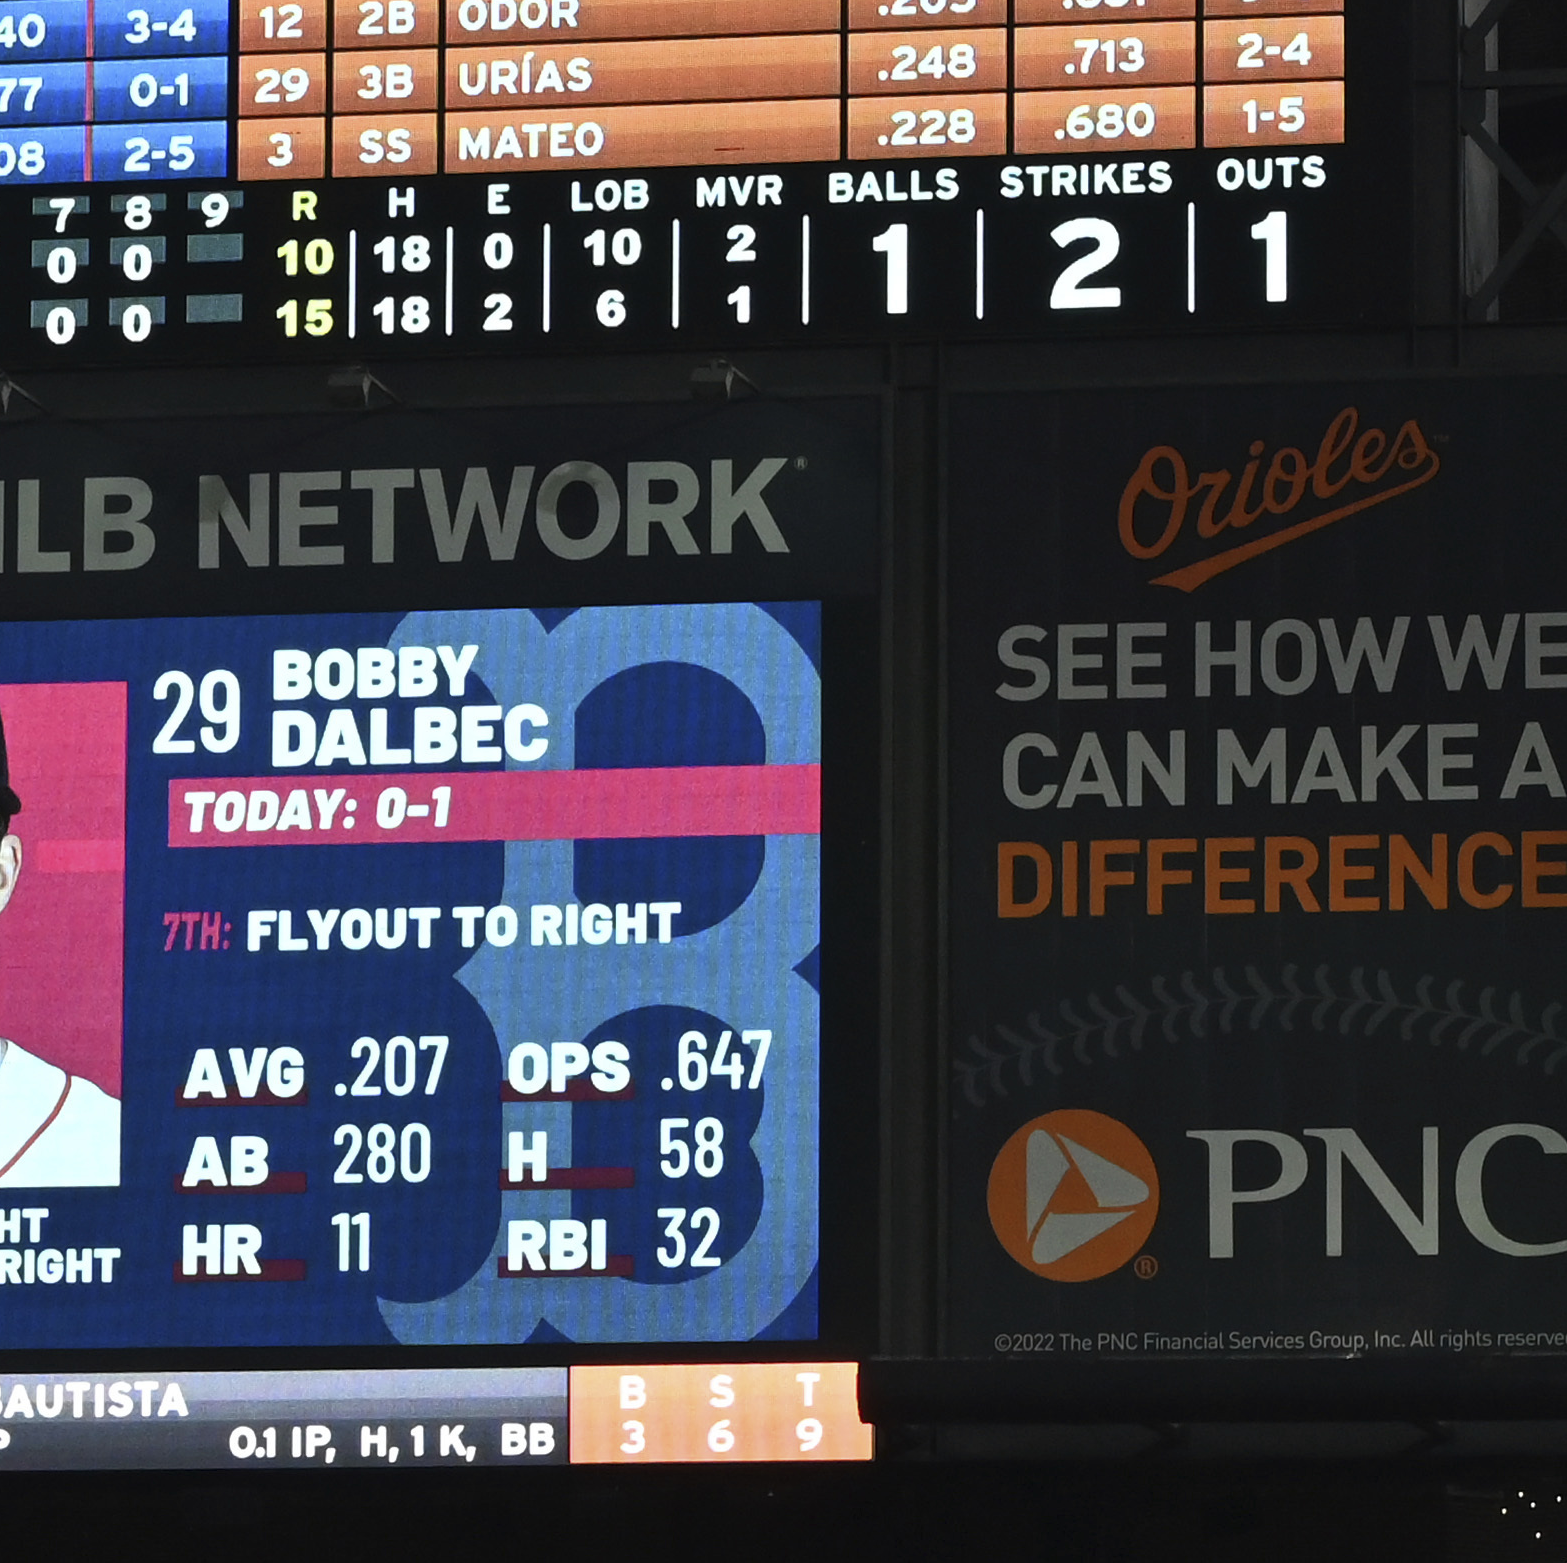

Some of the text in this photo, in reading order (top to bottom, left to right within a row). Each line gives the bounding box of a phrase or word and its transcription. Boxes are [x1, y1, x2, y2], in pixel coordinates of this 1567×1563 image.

[459, 51, 593, 96] URÍAS
[458, 121, 604, 161] MATEO
[292, 155, 1326, 221] R H E LOB MVR BALLS STRIKES OUTS
[276, 238, 334, 276] 10
[373, 235, 431, 273] 18
[483, 232, 514, 270] 0
[583, 228, 642, 266] 10
[725, 224, 756, 262] 2
[872, 211, 1287, 314] 1 2 1
[276, 298, 334, 338] 15
[373, 295, 431, 335] 18
[482, 293, 513, 331] 2
[596, 289, 627, 327] 6
[727, 285, 751, 323] 1
[198, 457, 791, 569] NETWORK
[1118, 406, 1440, 593] Orioles
[995, 621, 1167, 702] SEE
[1194, 617, 1410, 696] HOW
[152, 644, 480, 754] 29 BOBBY
[271, 703, 549, 768] DALBEC
[1002, 722, 1566, 810] CAN MAKE A
[184, 785, 452, 833] TODAY: 0-1
[163, 901, 682, 952] 7TH: FLYOUT TO RIGHT
[182, 1029, 773, 1099] AVG .207 OPS .647
[181, 1116, 724, 1187] AB 280 H 58
[182, 1207, 721, 1276] HR 11 RBI 32
[1059, 1333, 1092, 1350] The
[1097, 1332, 1138, 1350] PNC
[1143, 1330, 1224, 1350] Financial
[1228, 1331, 1304, 1349] Services
[1309, 1331, 1369, 1353] Group,
[1374, 1331, 1405, 1348] Inc.
[1410, 1329, 1434, 1347] All
[1439, 1328, 1491, 1351] rights
[620, 1373, 820, 1409] B S T
[229, 1423, 556, 1464] 0.1 IP, H, 1 K, BB
[620, 1418, 822, 1454] 3 6 9
